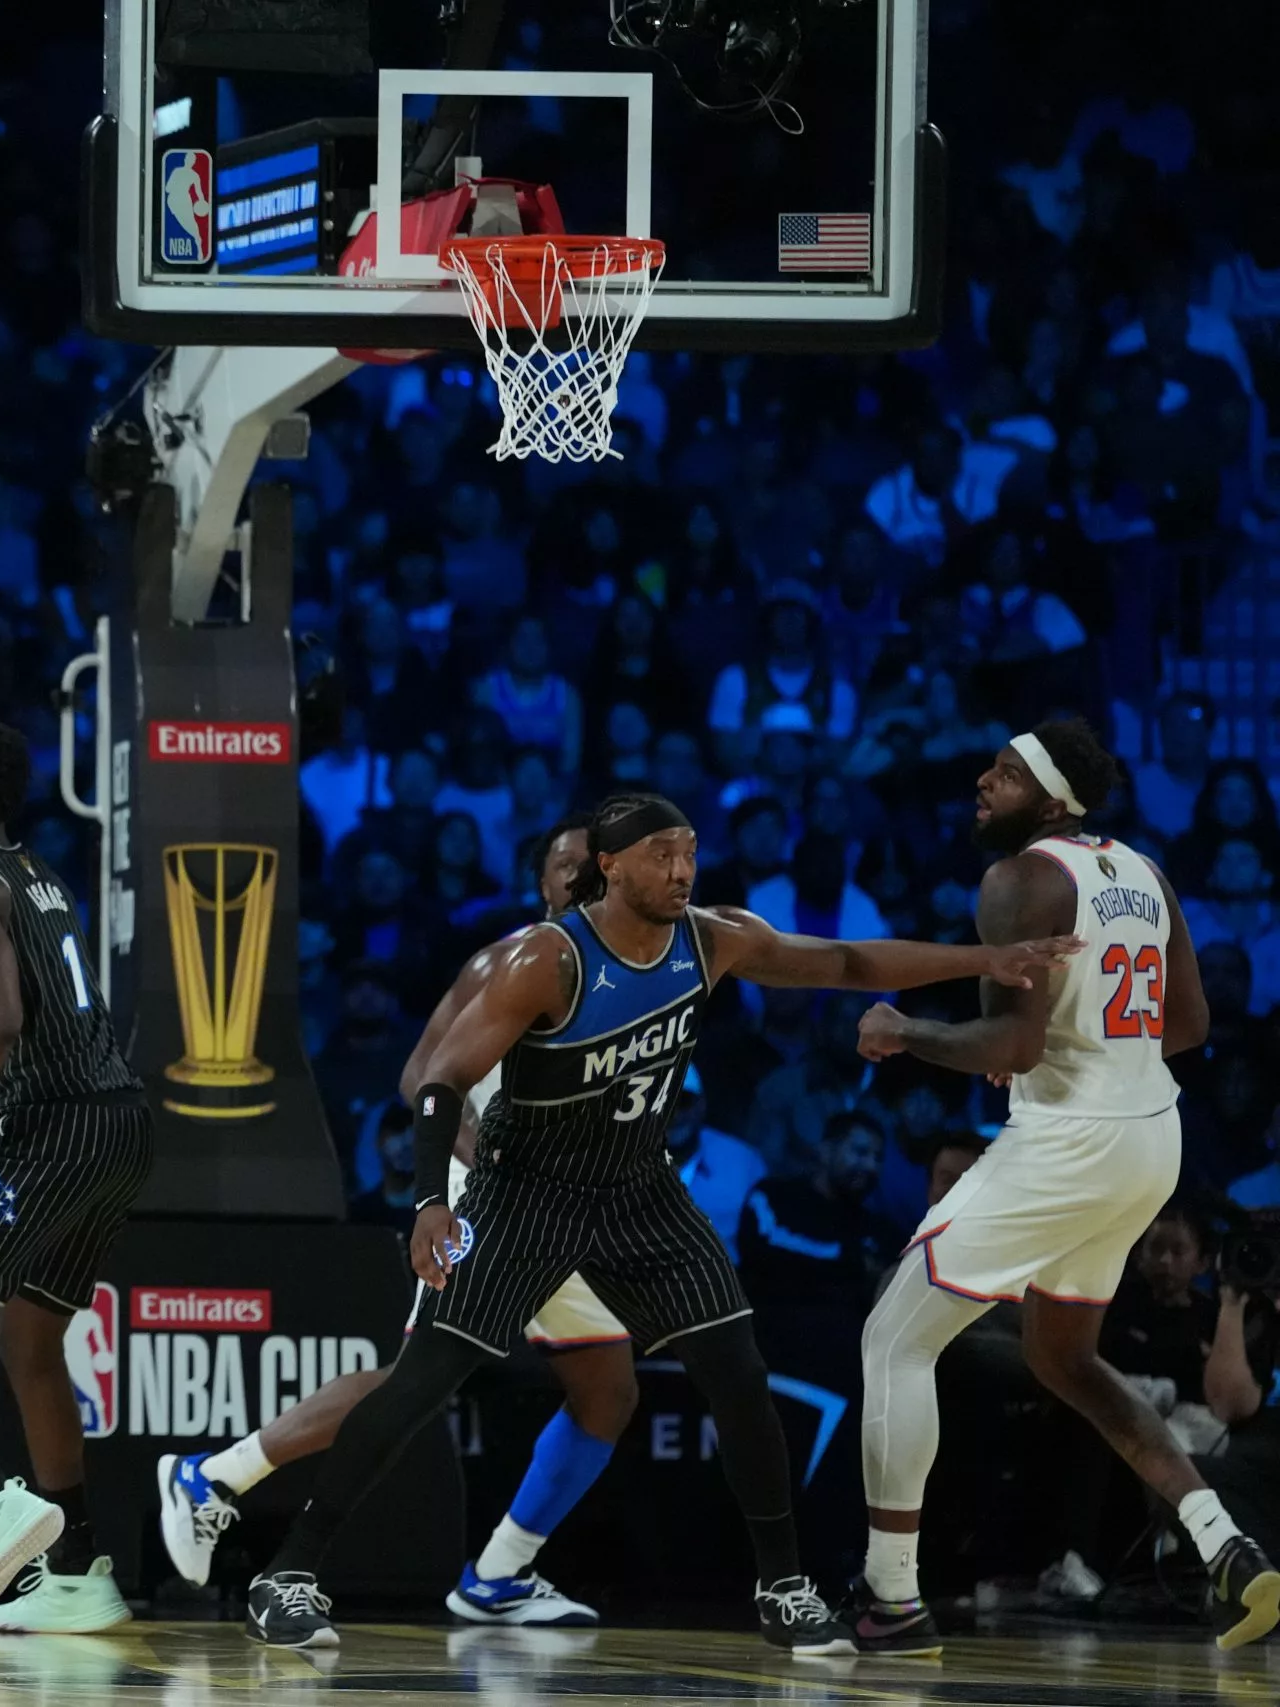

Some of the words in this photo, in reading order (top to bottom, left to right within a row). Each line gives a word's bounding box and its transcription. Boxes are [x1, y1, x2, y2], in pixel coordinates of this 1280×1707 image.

[169, 238, 193, 256] NBA
[158, 725, 282, 756] Emirates
[26, 881, 69, 914] ISAAC
[1091, 887, 1160, 929] ROBINSON
[61, 934, 90, 1009] 1
[1101, 943, 1165, 1040] 23
[613, 1067, 675, 1122] 34
[139, 1292, 264, 1322] Emirates
[128, 1333, 249, 1438] NBA
